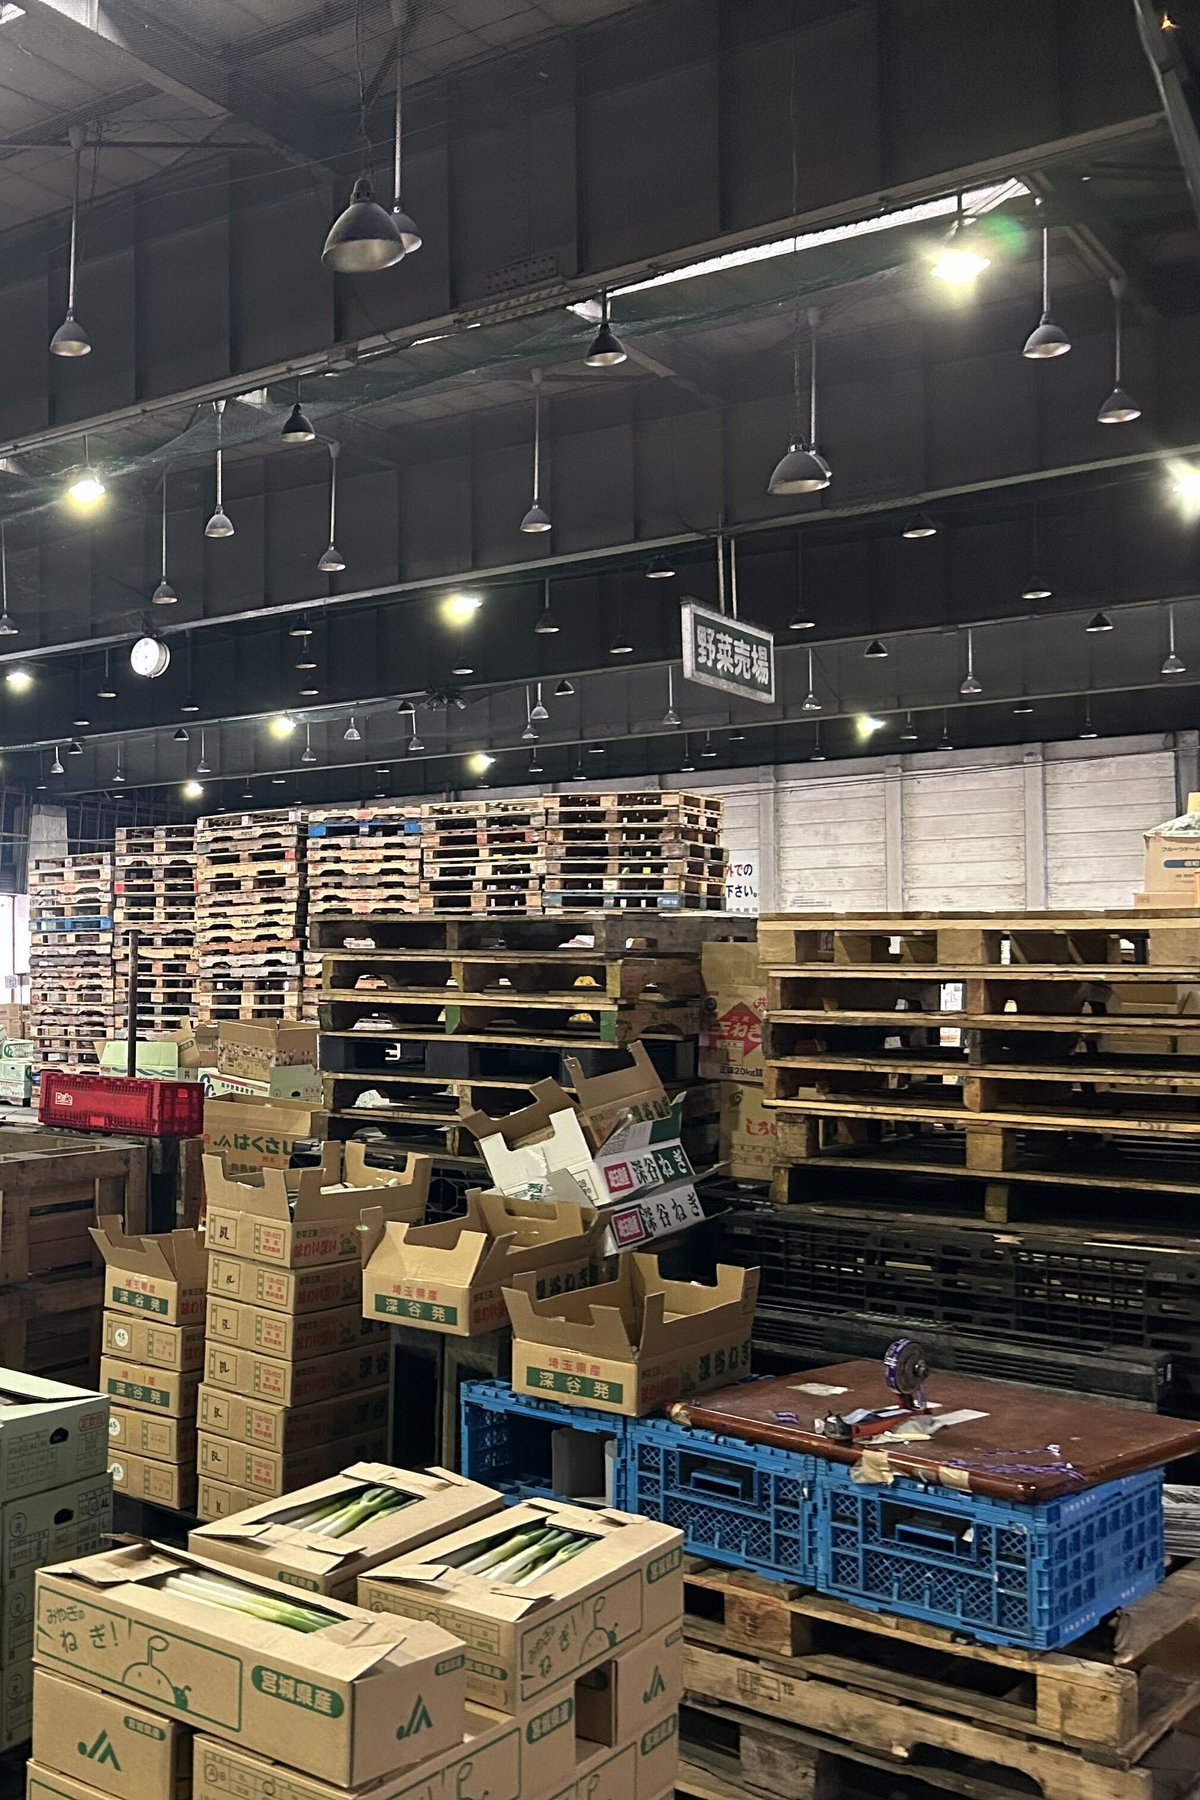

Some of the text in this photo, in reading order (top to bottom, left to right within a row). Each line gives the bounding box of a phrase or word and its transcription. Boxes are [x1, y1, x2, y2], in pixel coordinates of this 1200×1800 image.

[696, 624, 769, 685] 野菜売場
[56, 1091, 72, 1102] Dole
[629, 1148, 688, 1186] 深谷ねぎ
[639, 1191, 701, 1234] 深谷ねぎ
[119, 1290, 161, 1312] 深谷発
[392, 1284, 438, 1301] 埼玉県産
[385, 1298, 446, 1322] 深谷発
[548, 1356, 601, 1377] 埼玉県産
[115, 1382, 161, 1404] 深谷発
[539, 1371, 610, 1399] 深谷発
[47, 1605, 85, 1625] みやぎの
[260, 1669, 334, 1714] 宮城県産
